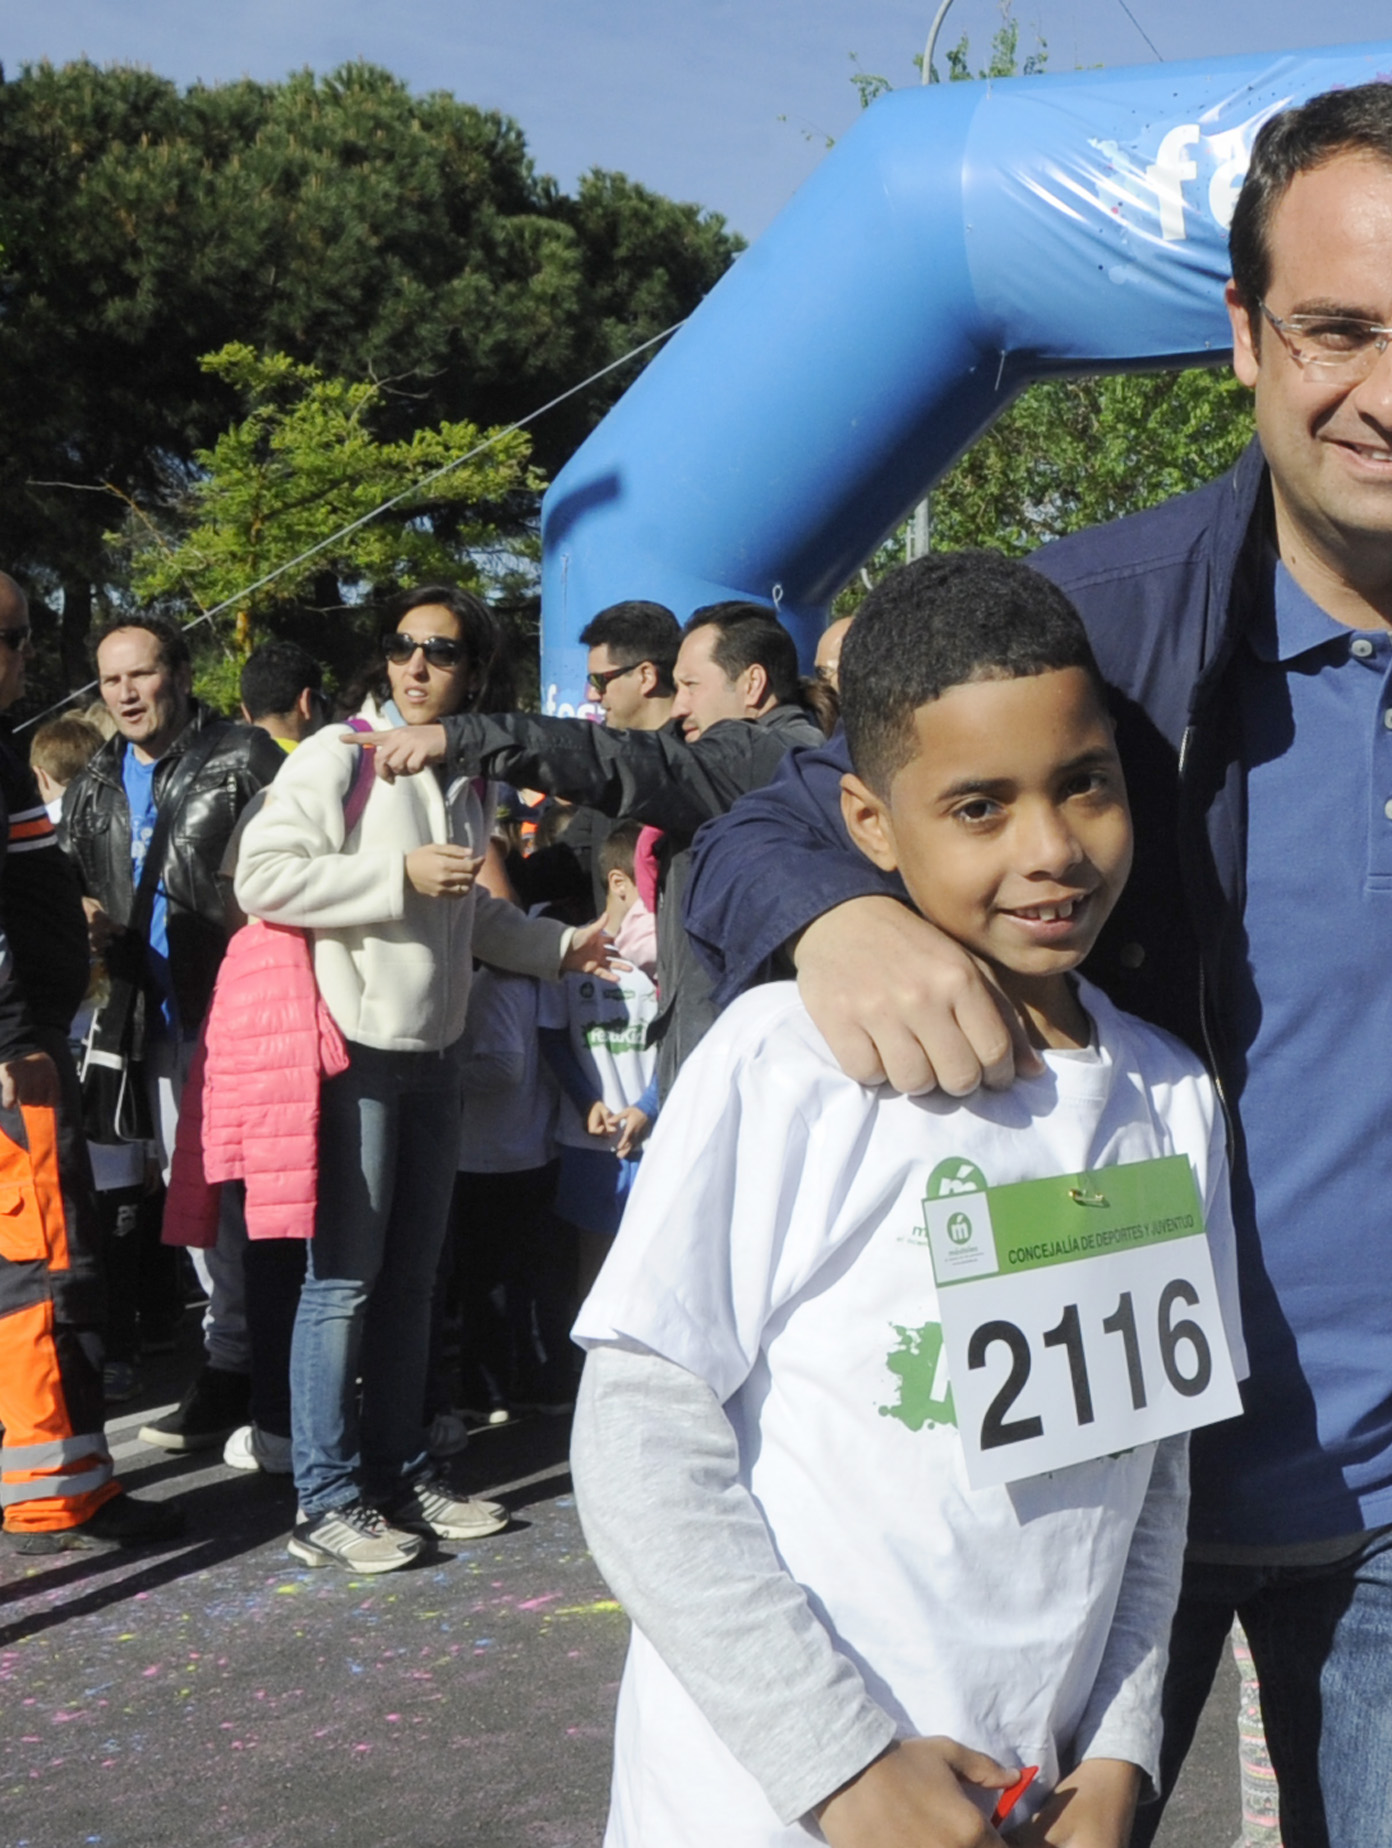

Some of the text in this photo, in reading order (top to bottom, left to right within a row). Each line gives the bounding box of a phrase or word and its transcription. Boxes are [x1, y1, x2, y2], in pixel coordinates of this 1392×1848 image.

[1008, 1234, 1080, 1265] CONCEJALÍA
[1081, 1234, 1097, 1251] DE
[1097, 1224, 1144, 1247] DEPORTES
[1143, 1223, 1152, 1238] Y
[1151, 1213, 1195, 1237] JUVENTUD
[967, 1278, 1213, 1452] 2116
